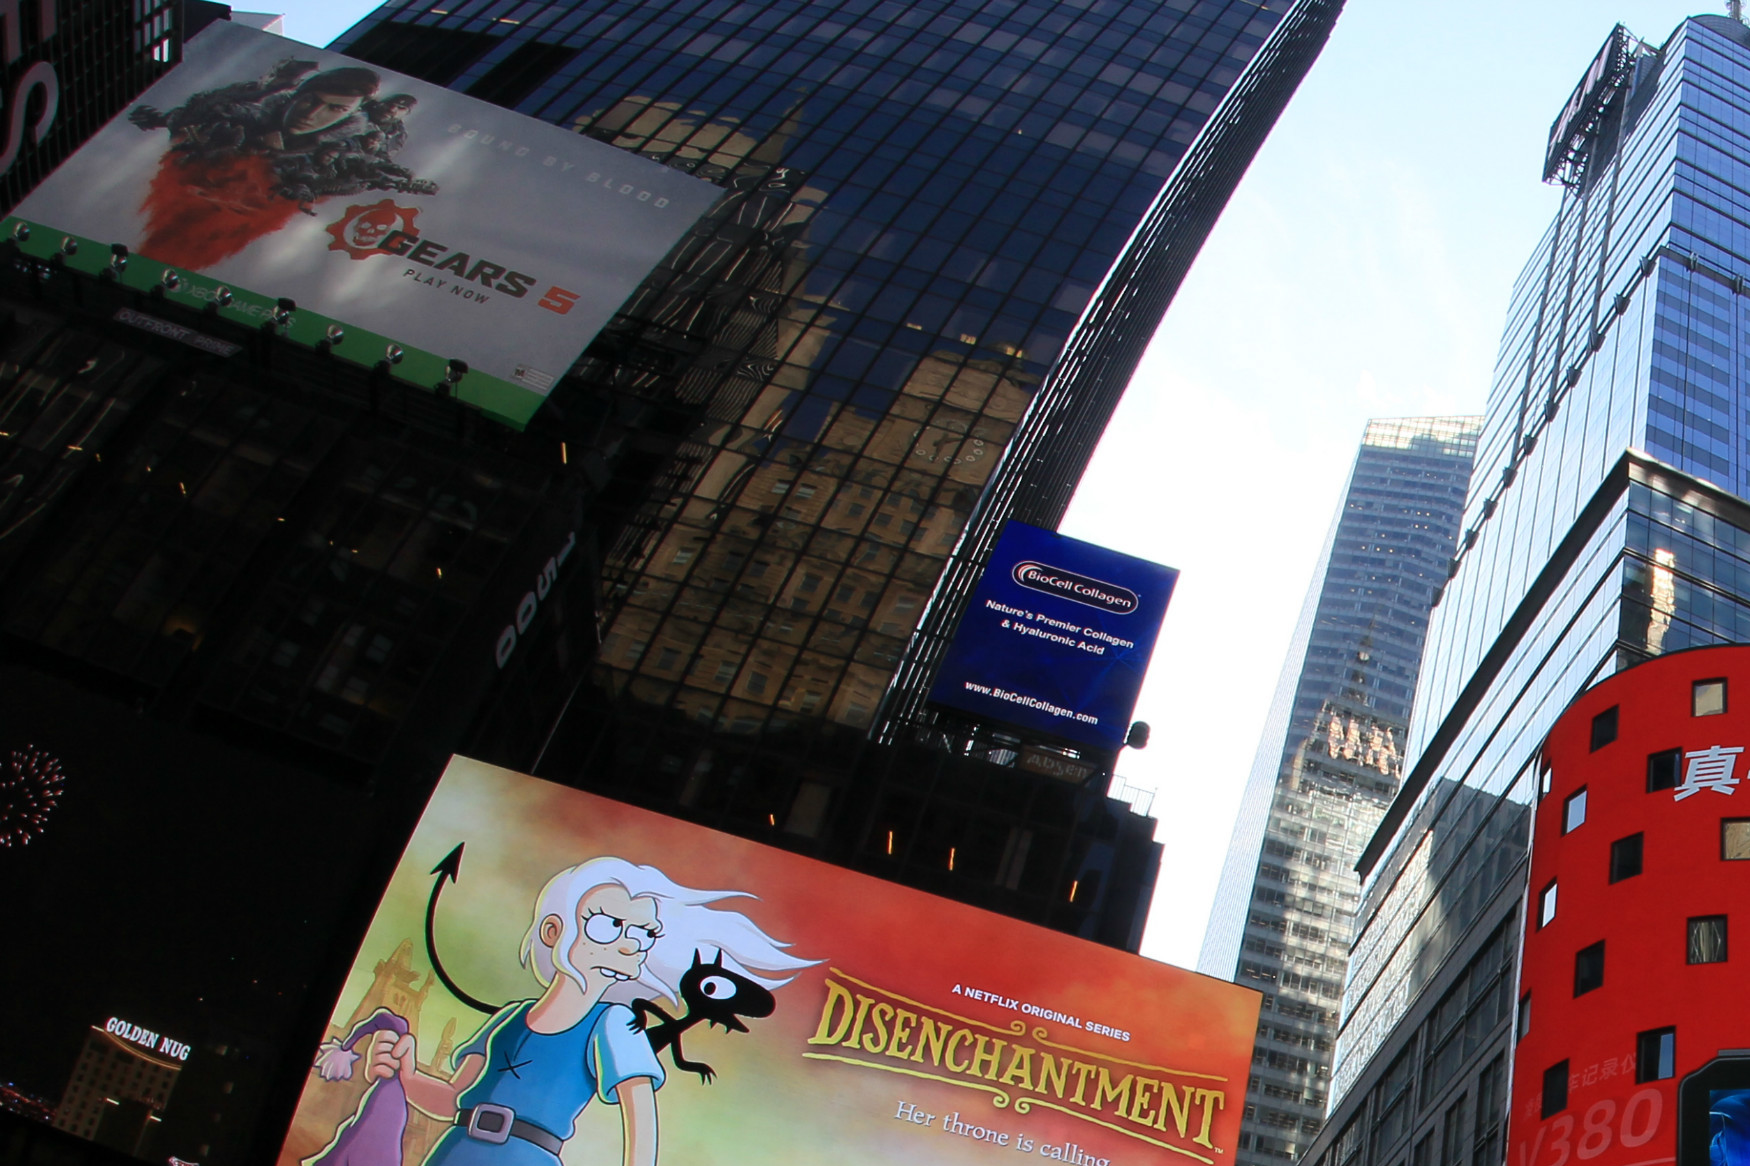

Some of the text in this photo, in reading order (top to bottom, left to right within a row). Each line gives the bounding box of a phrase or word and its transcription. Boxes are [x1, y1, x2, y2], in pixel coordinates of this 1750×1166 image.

[448, 123, 669, 208] BOUND BY BLOOD
[378, 230, 581, 315] GEARS 5
[403, 268, 490, 304] PLAY NOW
[118, 311, 236, 355] OUTFRONT PRIME
[1027, 569, 1132, 608] BioCell Collagen
[985, 599, 1135, 649] Nature's Premier Collagen
[1001, 618, 1106, 656] & Hyaluronic Acid
[964, 681, 1099, 726] www.BioCellCollagen.com
[952, 984, 1132, 1042] A NETFLIX ORIGINAL SERIES
[105, 1016, 192, 1061] GOLDEN NUG
[807, 978, 1226, 1149] DISENCHANTMENT
[894, 1100, 936, 1128] Her
[942, 1112, 1010, 1147] throne
[1015, 1132, 1035, 1153] is
